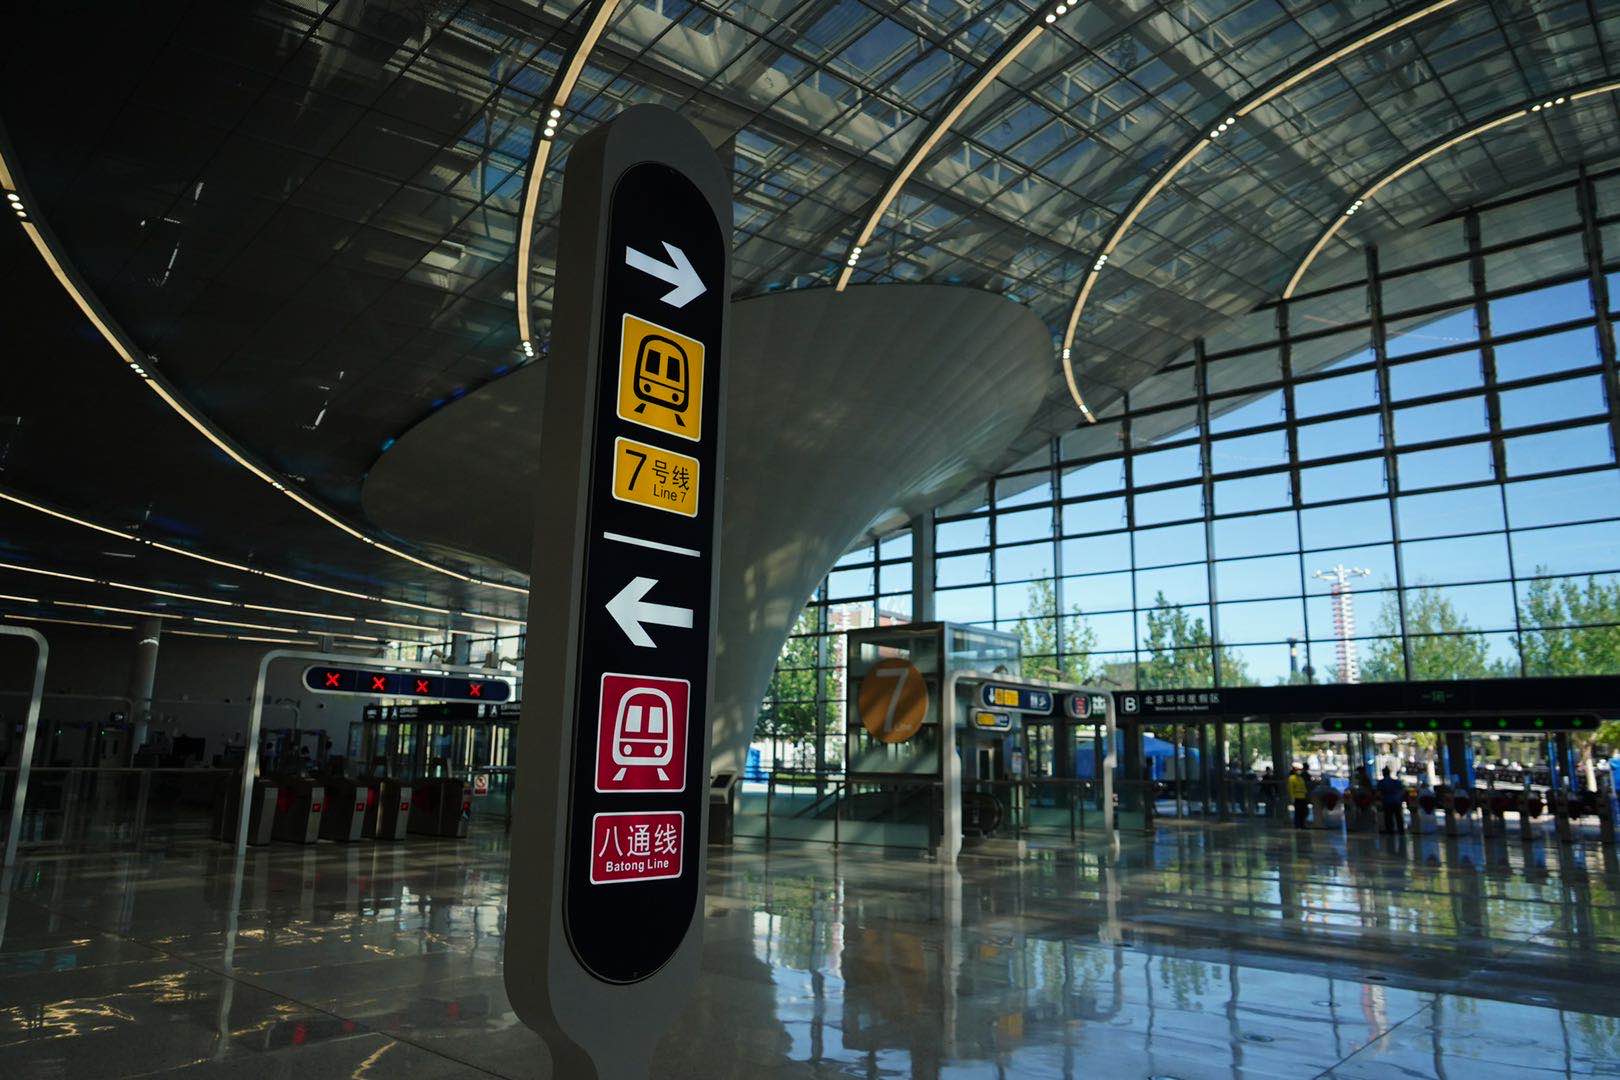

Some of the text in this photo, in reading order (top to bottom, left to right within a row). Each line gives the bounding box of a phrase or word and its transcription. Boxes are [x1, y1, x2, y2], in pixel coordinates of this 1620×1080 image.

[625, 449, 689, 491] 7号线
[653, 484, 687, 503] Line 7
[876, 668, 909, 732] 7
[1124, 696, 1137, 712] B
[598, 823, 677, 857] 八通线
[605, 858, 669, 873] Batong Line
